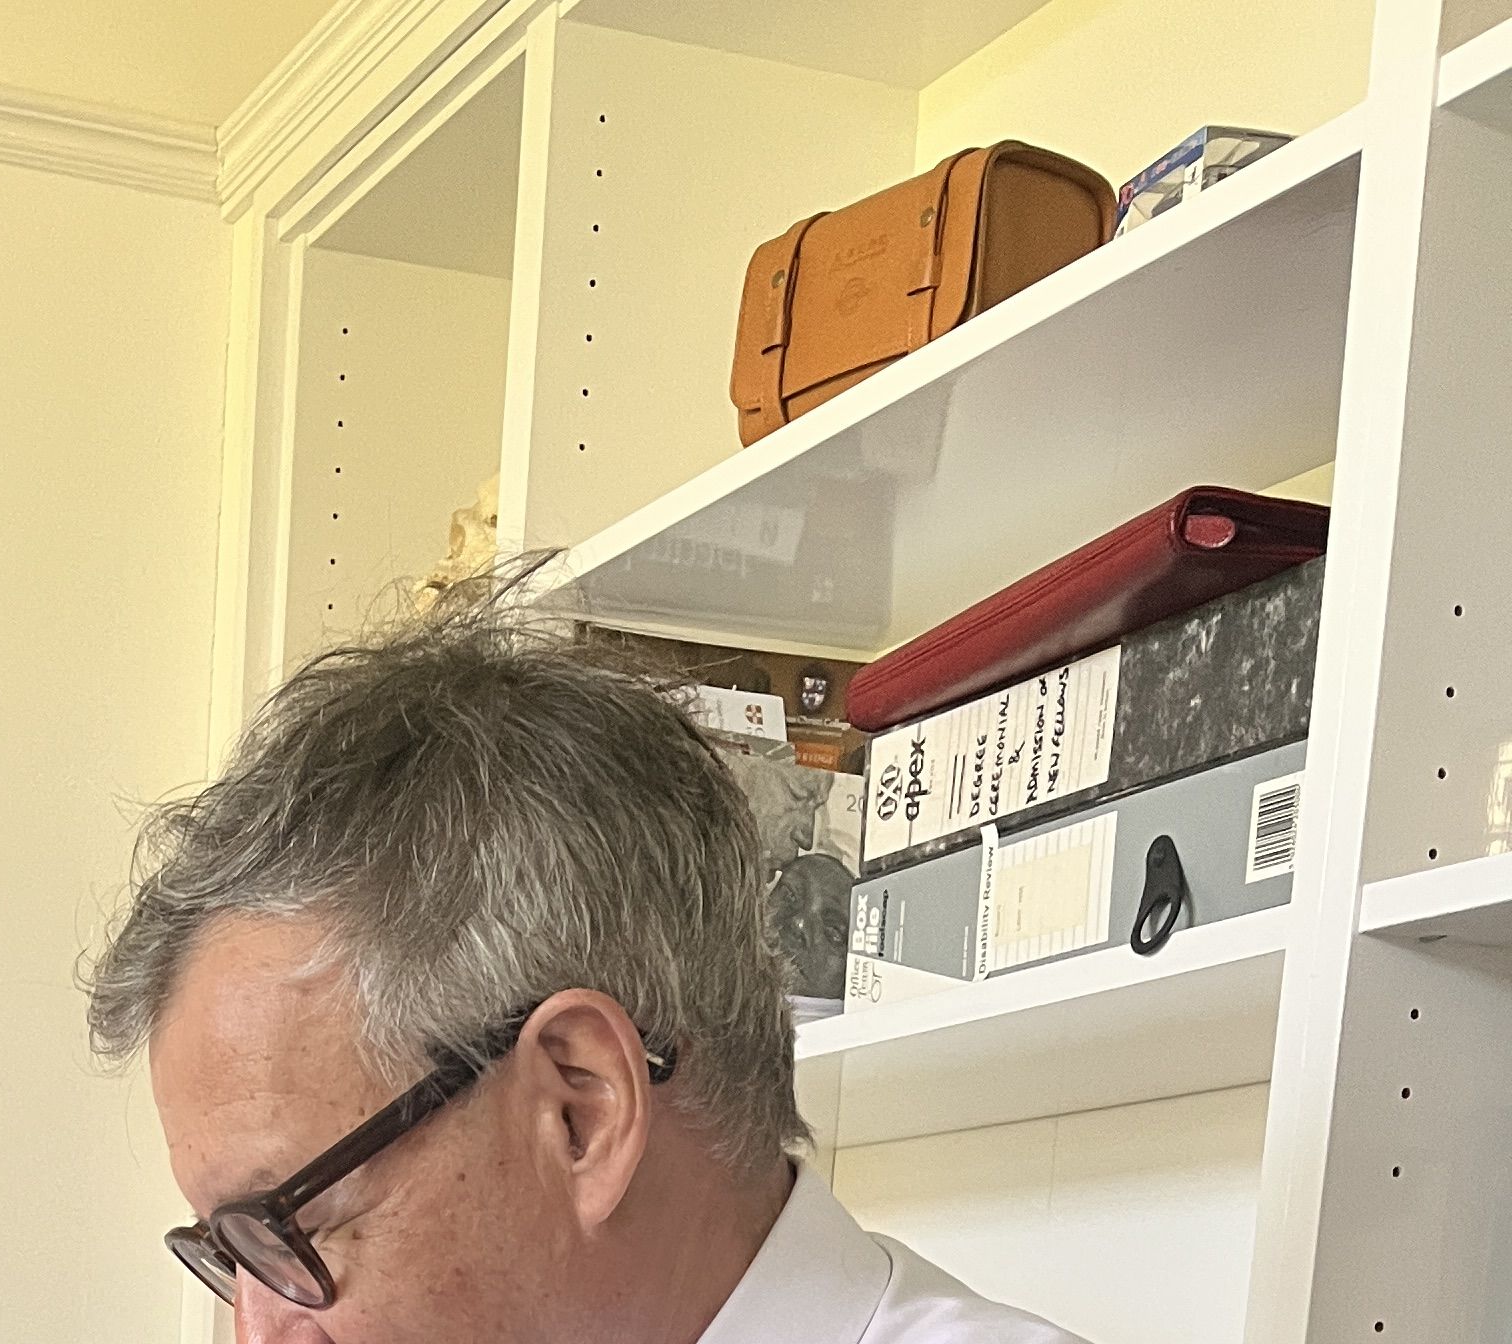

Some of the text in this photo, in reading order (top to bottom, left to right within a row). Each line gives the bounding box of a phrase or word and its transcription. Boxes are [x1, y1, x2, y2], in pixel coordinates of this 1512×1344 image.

[969, 734, 987, 818] DEGREE
[988, 693, 1010, 816] CEREMONIAL
[1026, 704, 1045, 805] ADMISSION
[1047, 666, 1070, 793] NEW FELLOWS
[904, 736, 926, 821] apex
[852, 894, 868, 951] Box
[865, 907, 879, 954] file
[978, 846, 994, 975] Disability Review
